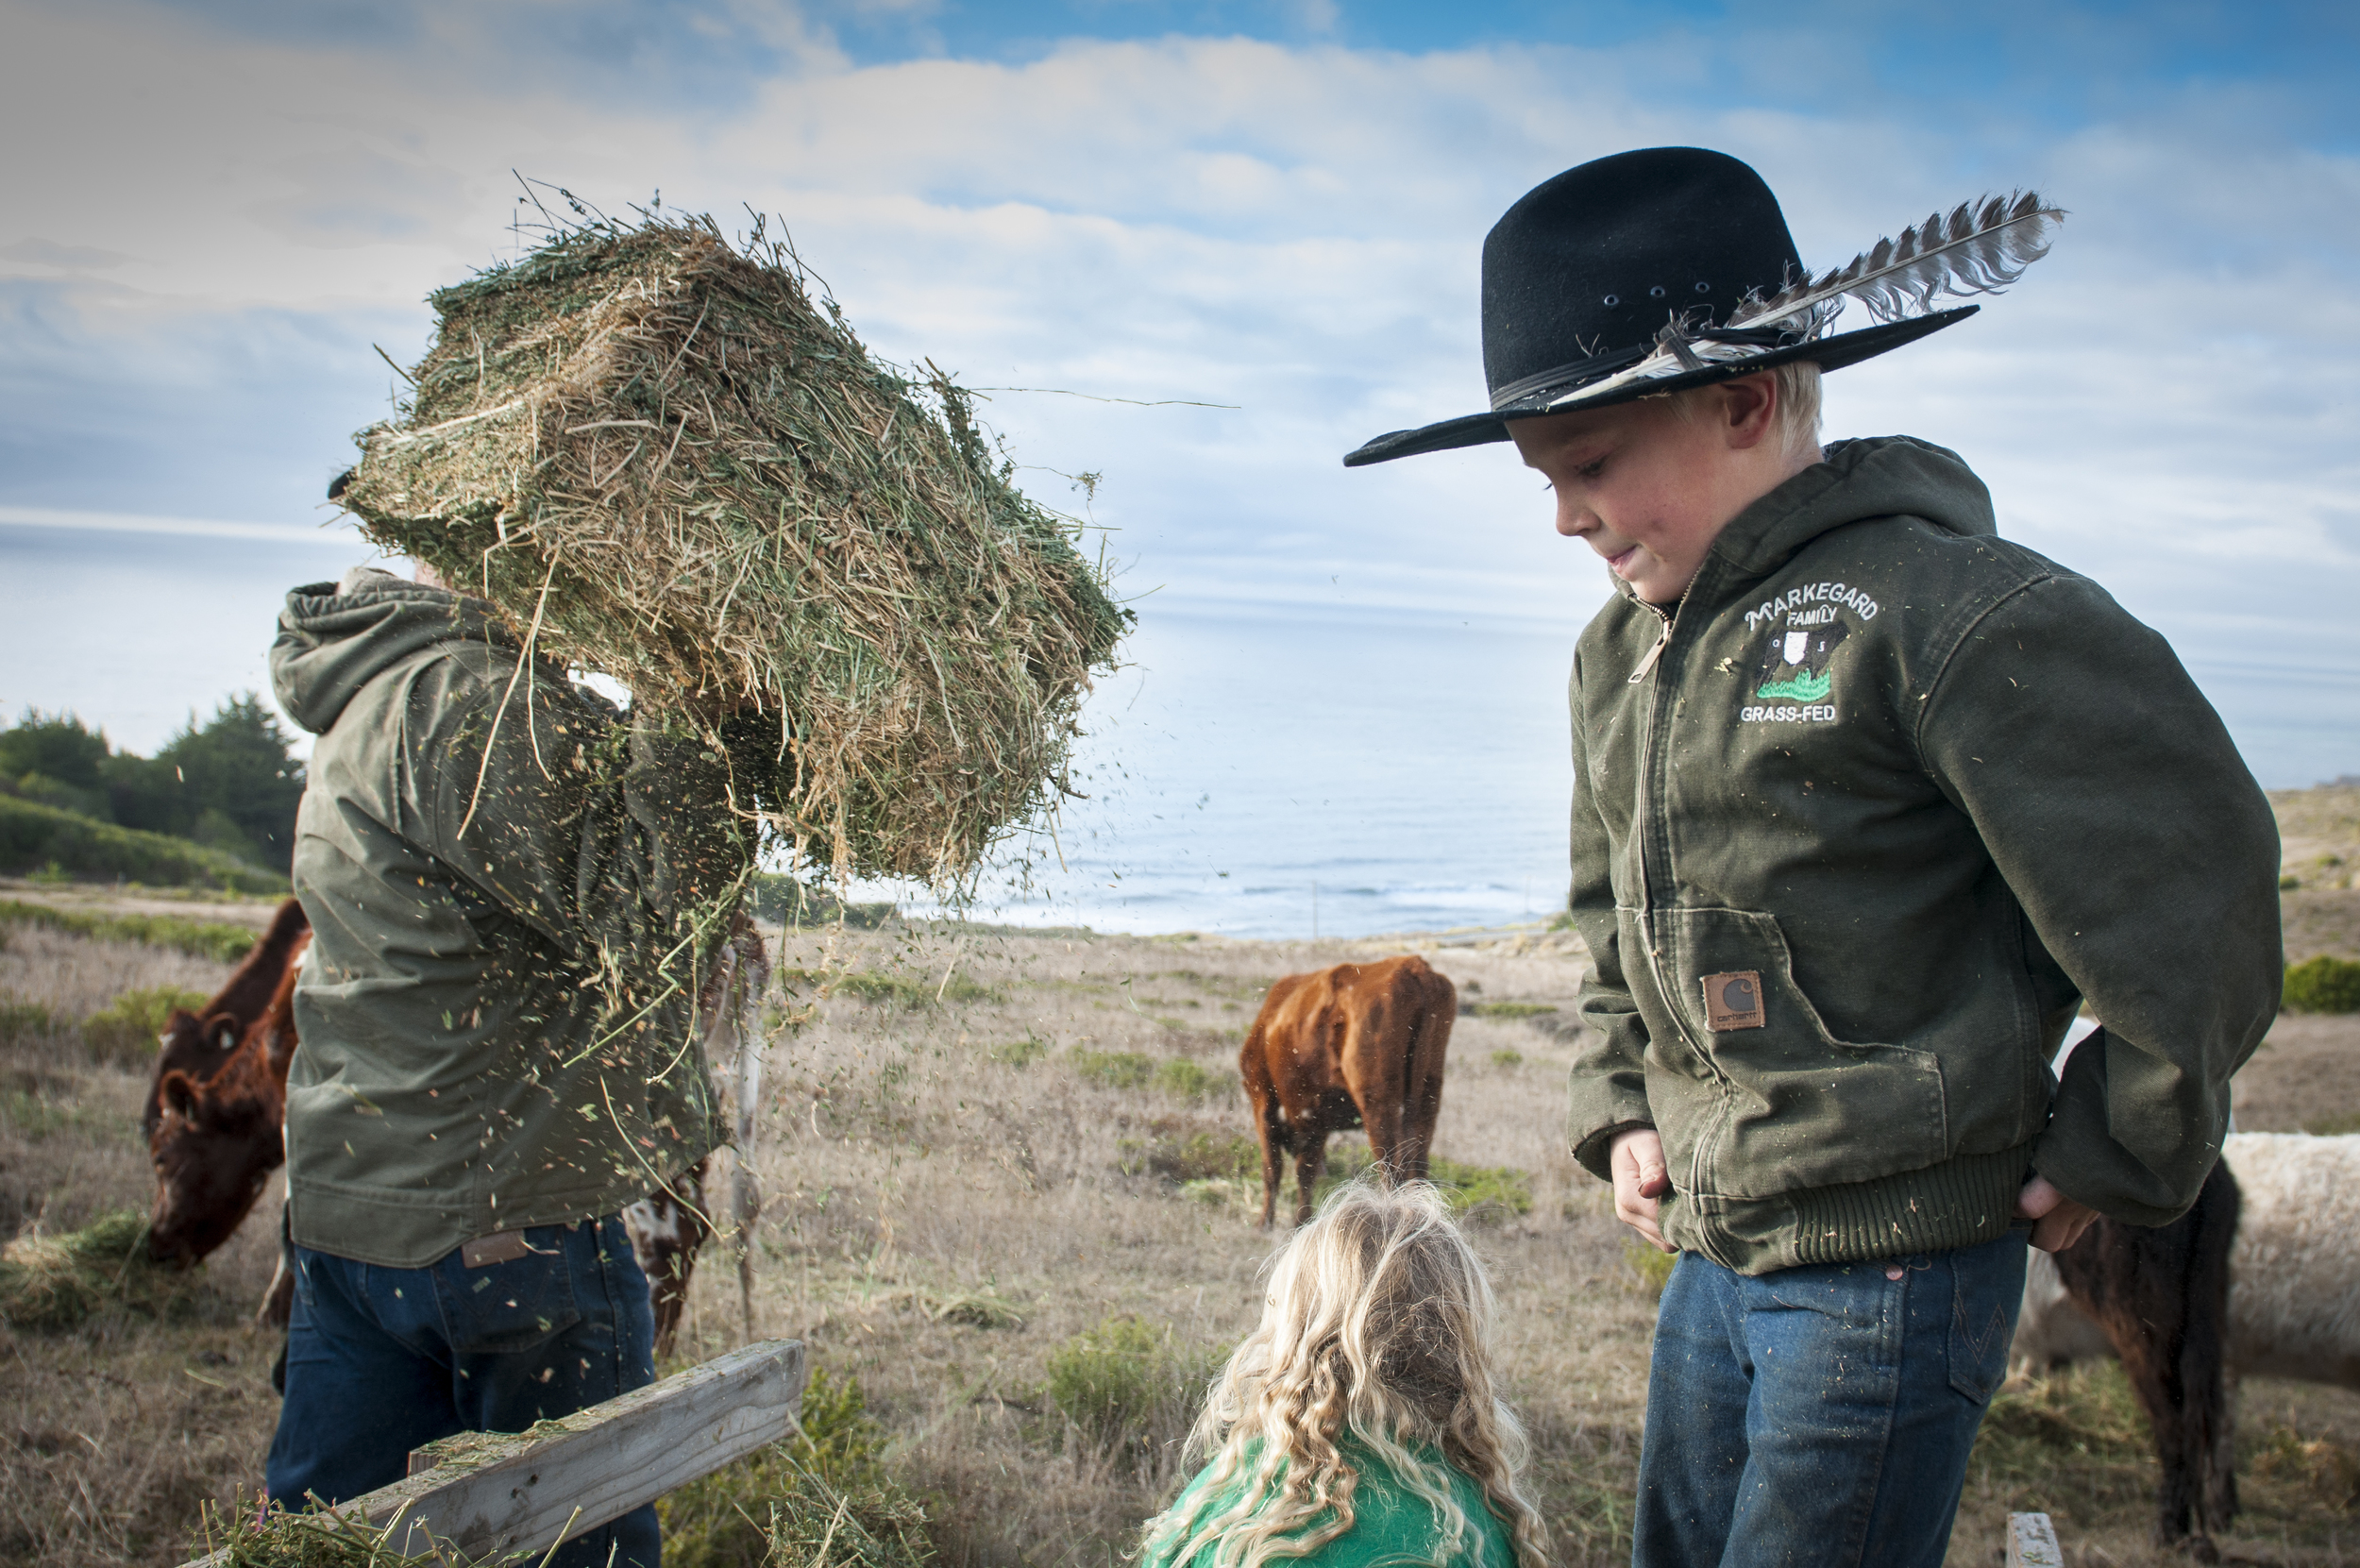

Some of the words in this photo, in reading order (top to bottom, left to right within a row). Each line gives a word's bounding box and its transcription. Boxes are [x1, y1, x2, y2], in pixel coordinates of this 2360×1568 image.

[1745, 582, 1879, 631] MARKEGARD
[1786, 604, 1837, 627] FAMILY
[1741, 705, 1835, 722] GRASS-FED
[1717, 1012, 1757, 1021] carhartt
